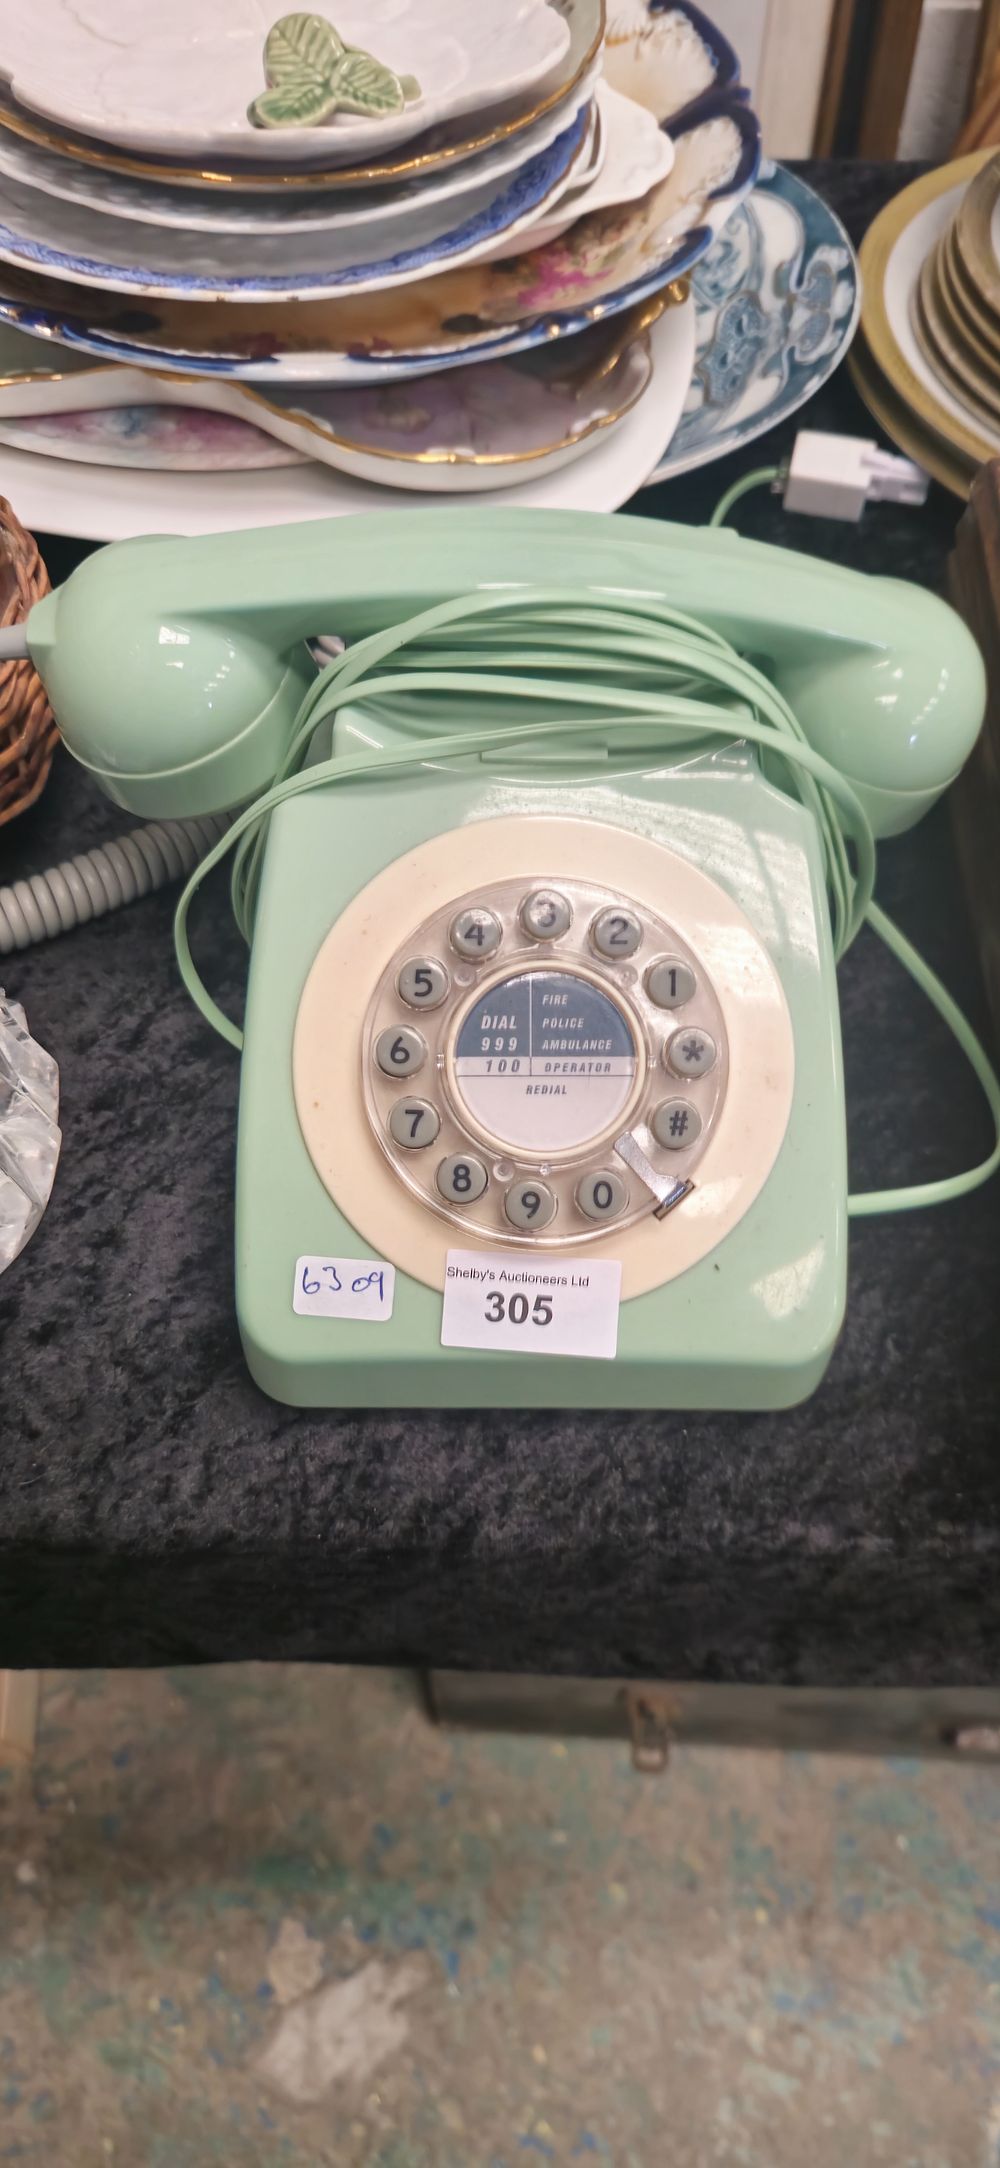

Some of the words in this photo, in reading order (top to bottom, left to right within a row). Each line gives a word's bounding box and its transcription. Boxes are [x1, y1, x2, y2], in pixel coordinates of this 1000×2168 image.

[463, 923, 485, 947] 4
[609, 918, 629, 945] 2
[414, 968, 433, 998] 5
[667, 968, 677, 997] 1
[541, 994, 569, 1006] FIRE
[480, 1015, 518, 1030] DIAL
[541, 1017, 585, 1029] POLICE
[389, 1036, 411, 1065] 6
[541, 1039, 613, 1051] AMBULANCE
[485, 1058, 521, 1073] 100
[544, 1062, 612, 1073] OPERATOR
[525, 1084, 568, 1096] REDIAL
[404, 1109, 425, 1138] 7
[452, 1163, 472, 1193] 8
[520, 1190, 541, 1219] 9
[592, 1180, 613, 1209] 0
[446, 1266, 496, 1282] Shelby's
[498, 1269, 568, 1286] Auctioneers
[570, 1273, 590, 1288] Ltd
[484, 1290, 554, 1326] 305
